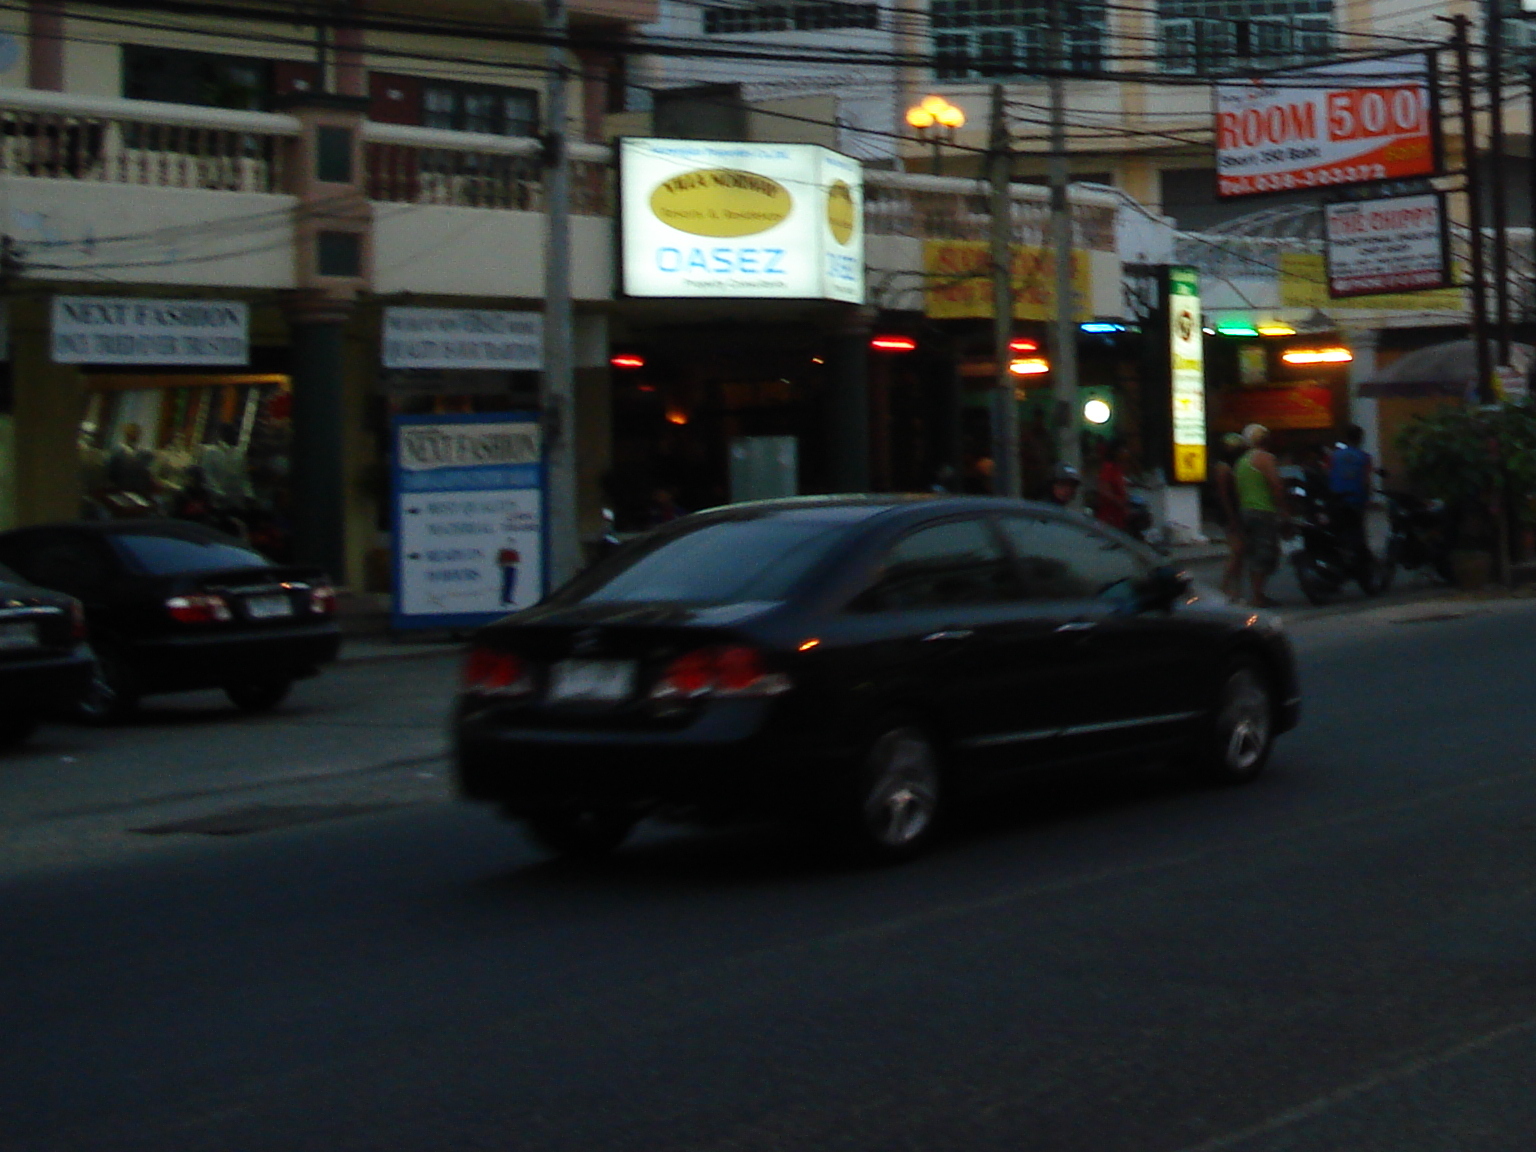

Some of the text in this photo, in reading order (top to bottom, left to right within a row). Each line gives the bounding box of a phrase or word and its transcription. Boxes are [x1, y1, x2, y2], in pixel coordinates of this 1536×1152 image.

[1217, 88, 1417, 150] ROOM 500
[63, 303, 126, 325] NEXT
